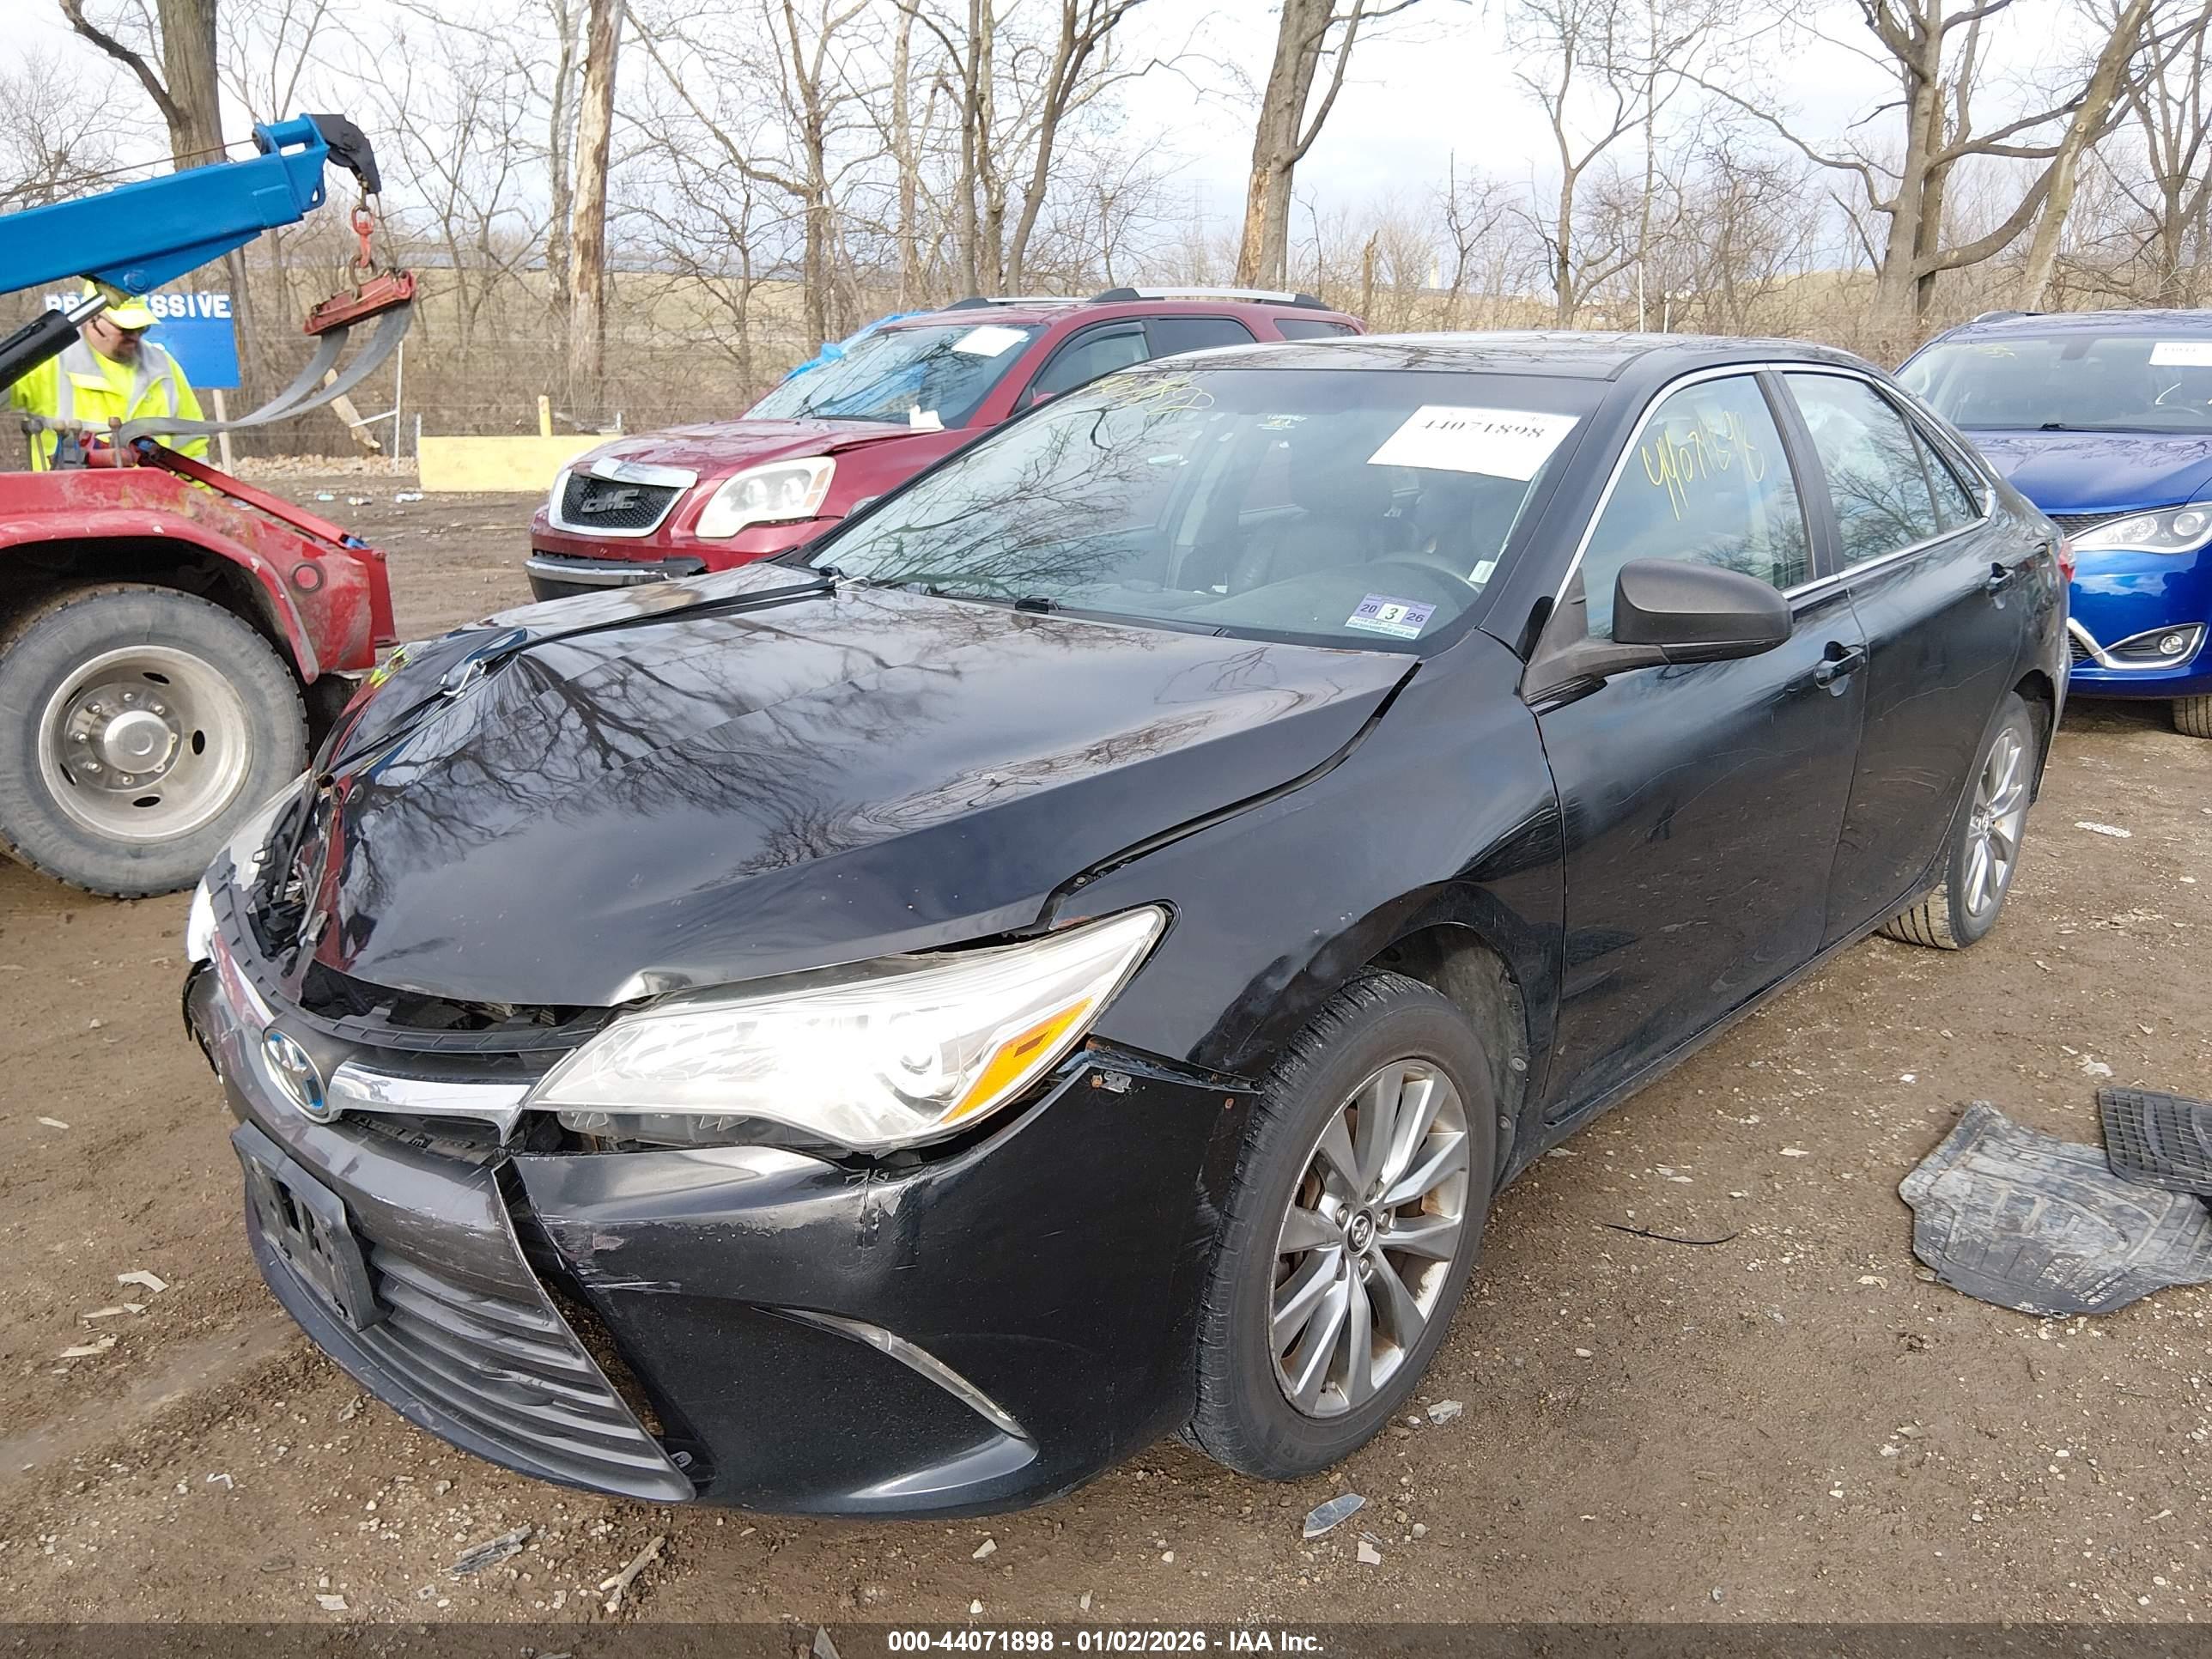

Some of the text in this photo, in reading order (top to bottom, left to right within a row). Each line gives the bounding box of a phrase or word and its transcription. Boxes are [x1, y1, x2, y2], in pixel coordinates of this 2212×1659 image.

[45, 294, 232, 319] PRSSIVE
[1419, 419, 1546, 439] 44071898
[1360, 604, 1425, 623] 20 3 26
